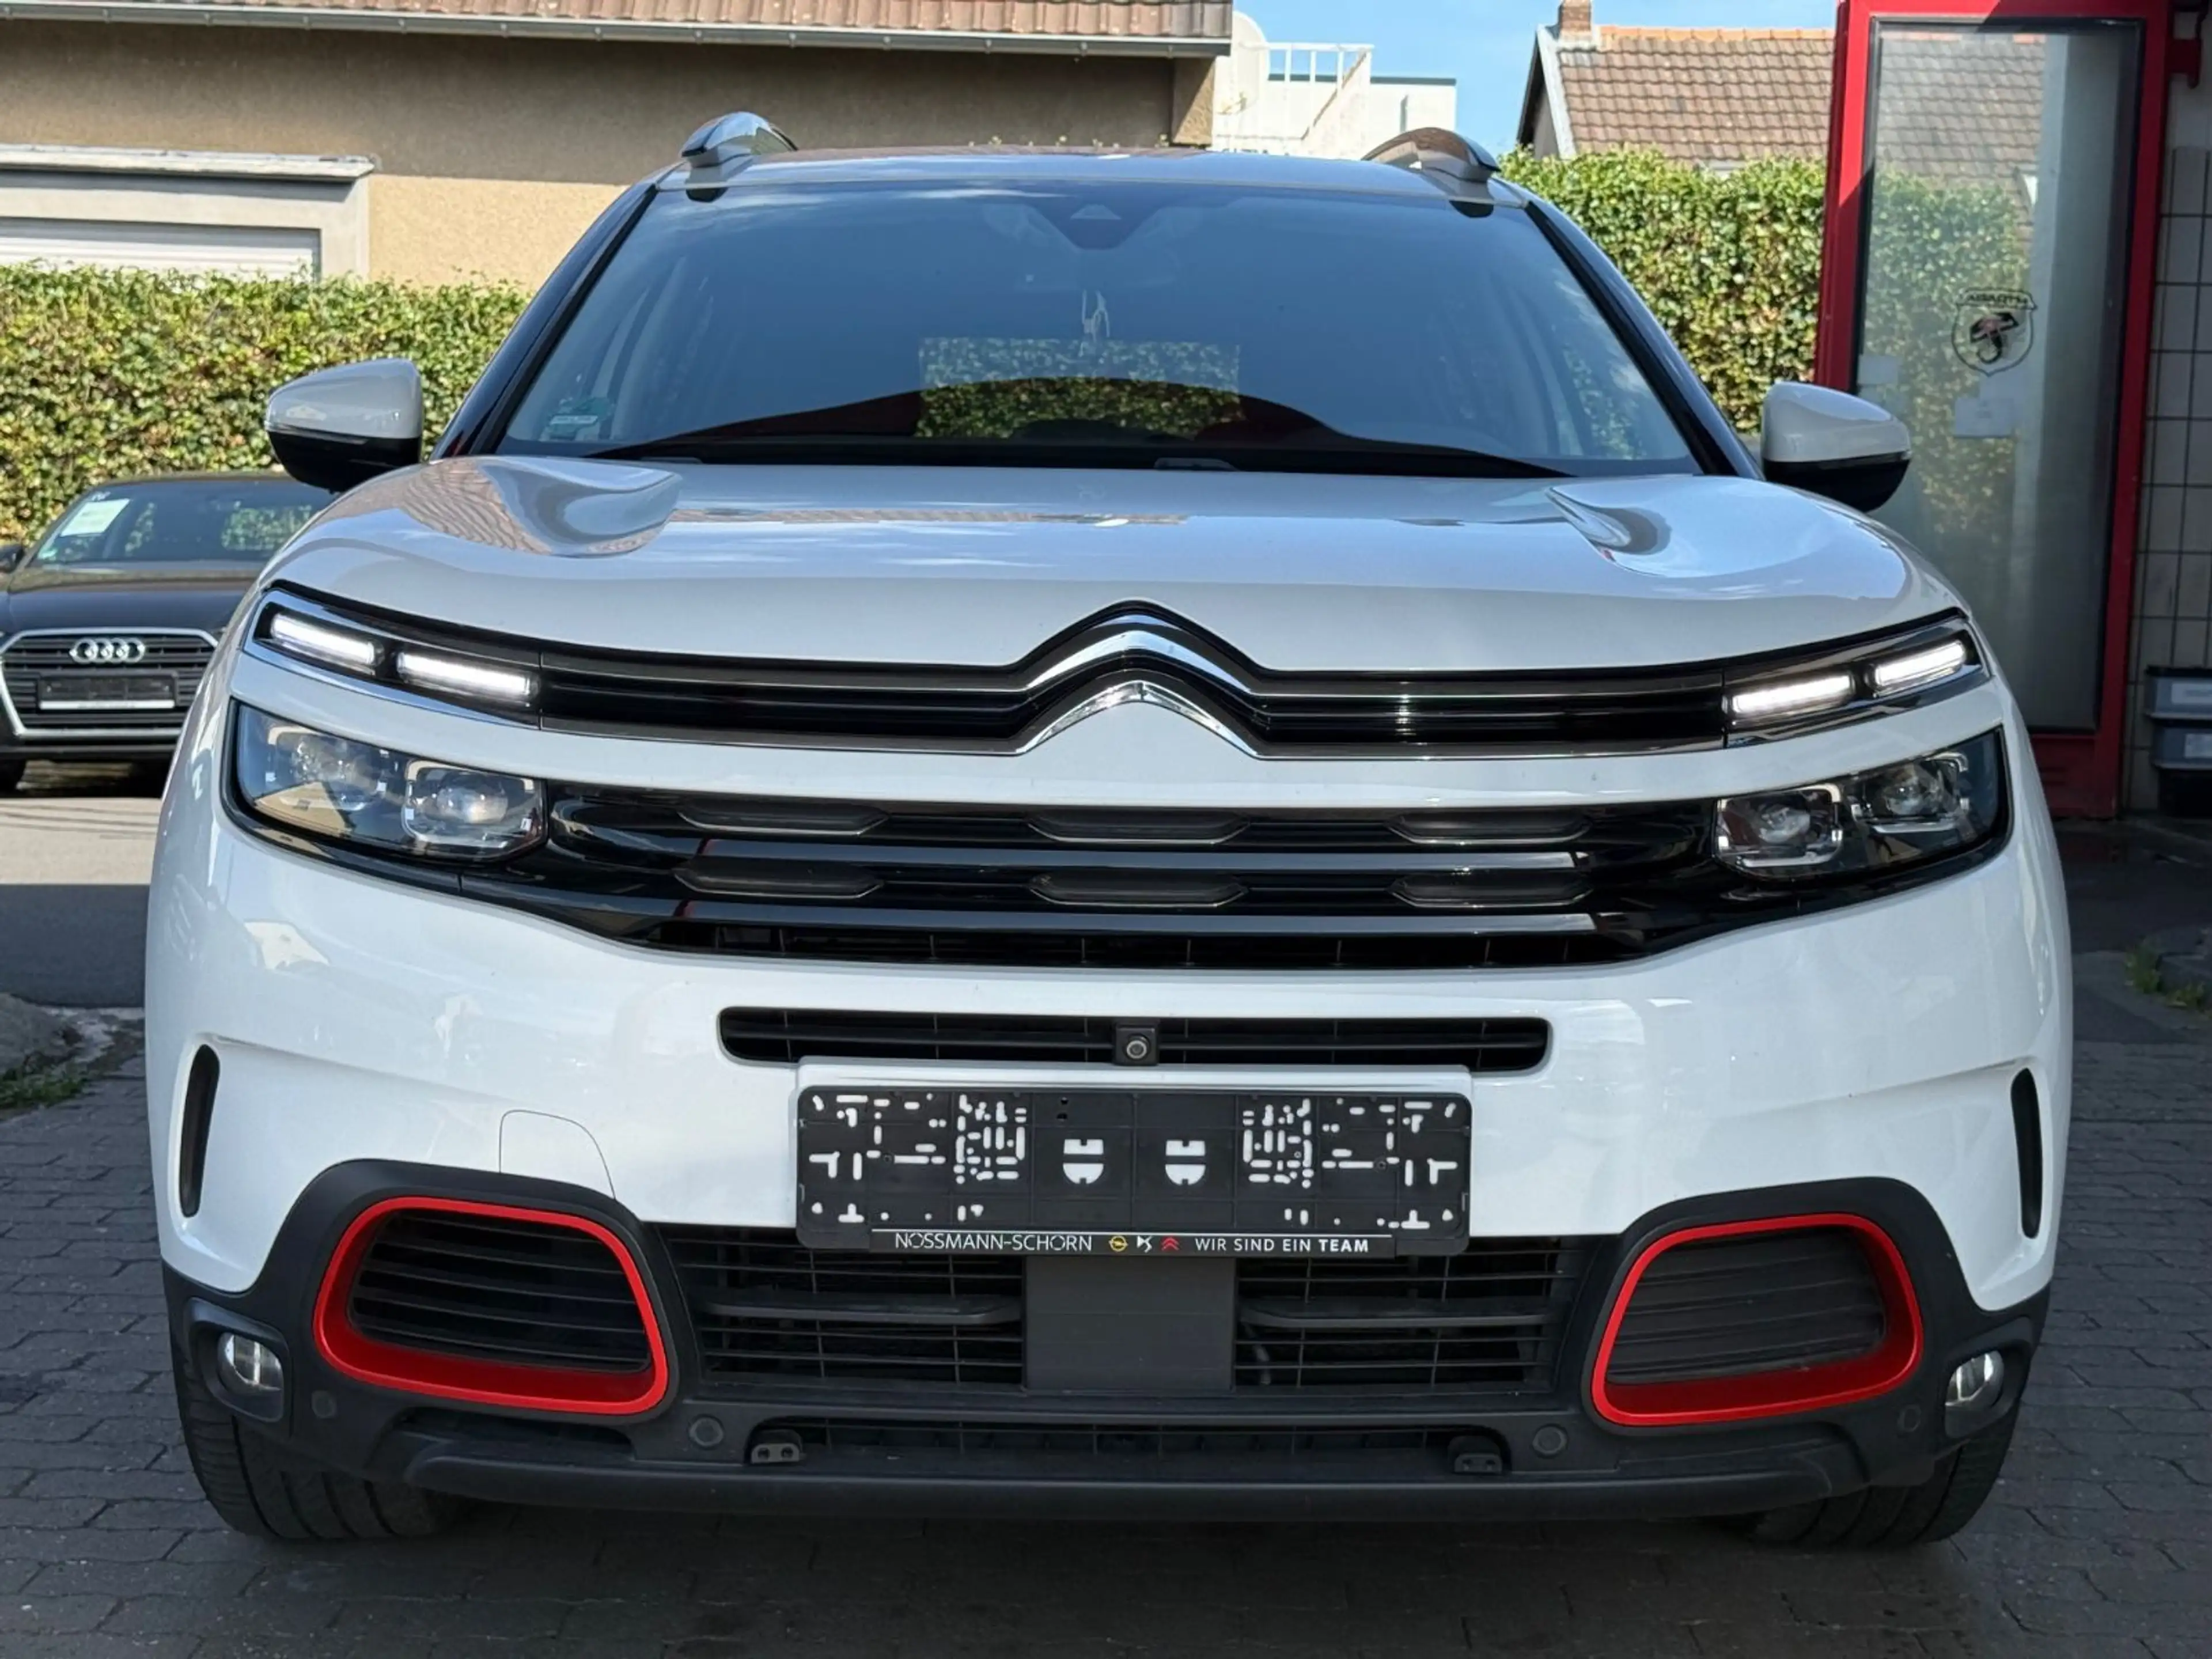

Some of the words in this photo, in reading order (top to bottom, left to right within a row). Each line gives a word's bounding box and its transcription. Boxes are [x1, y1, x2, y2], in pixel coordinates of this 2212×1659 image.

[895, 1232, 1092, 1252] NOSSMANN-SCHORN
[1195, 1238, 1226, 1251] WIR
[1234, 1238, 1275, 1252] SIND
[1282, 1238, 1310, 1252] EIN
[1318, 1238, 1369, 1253] TEAM
